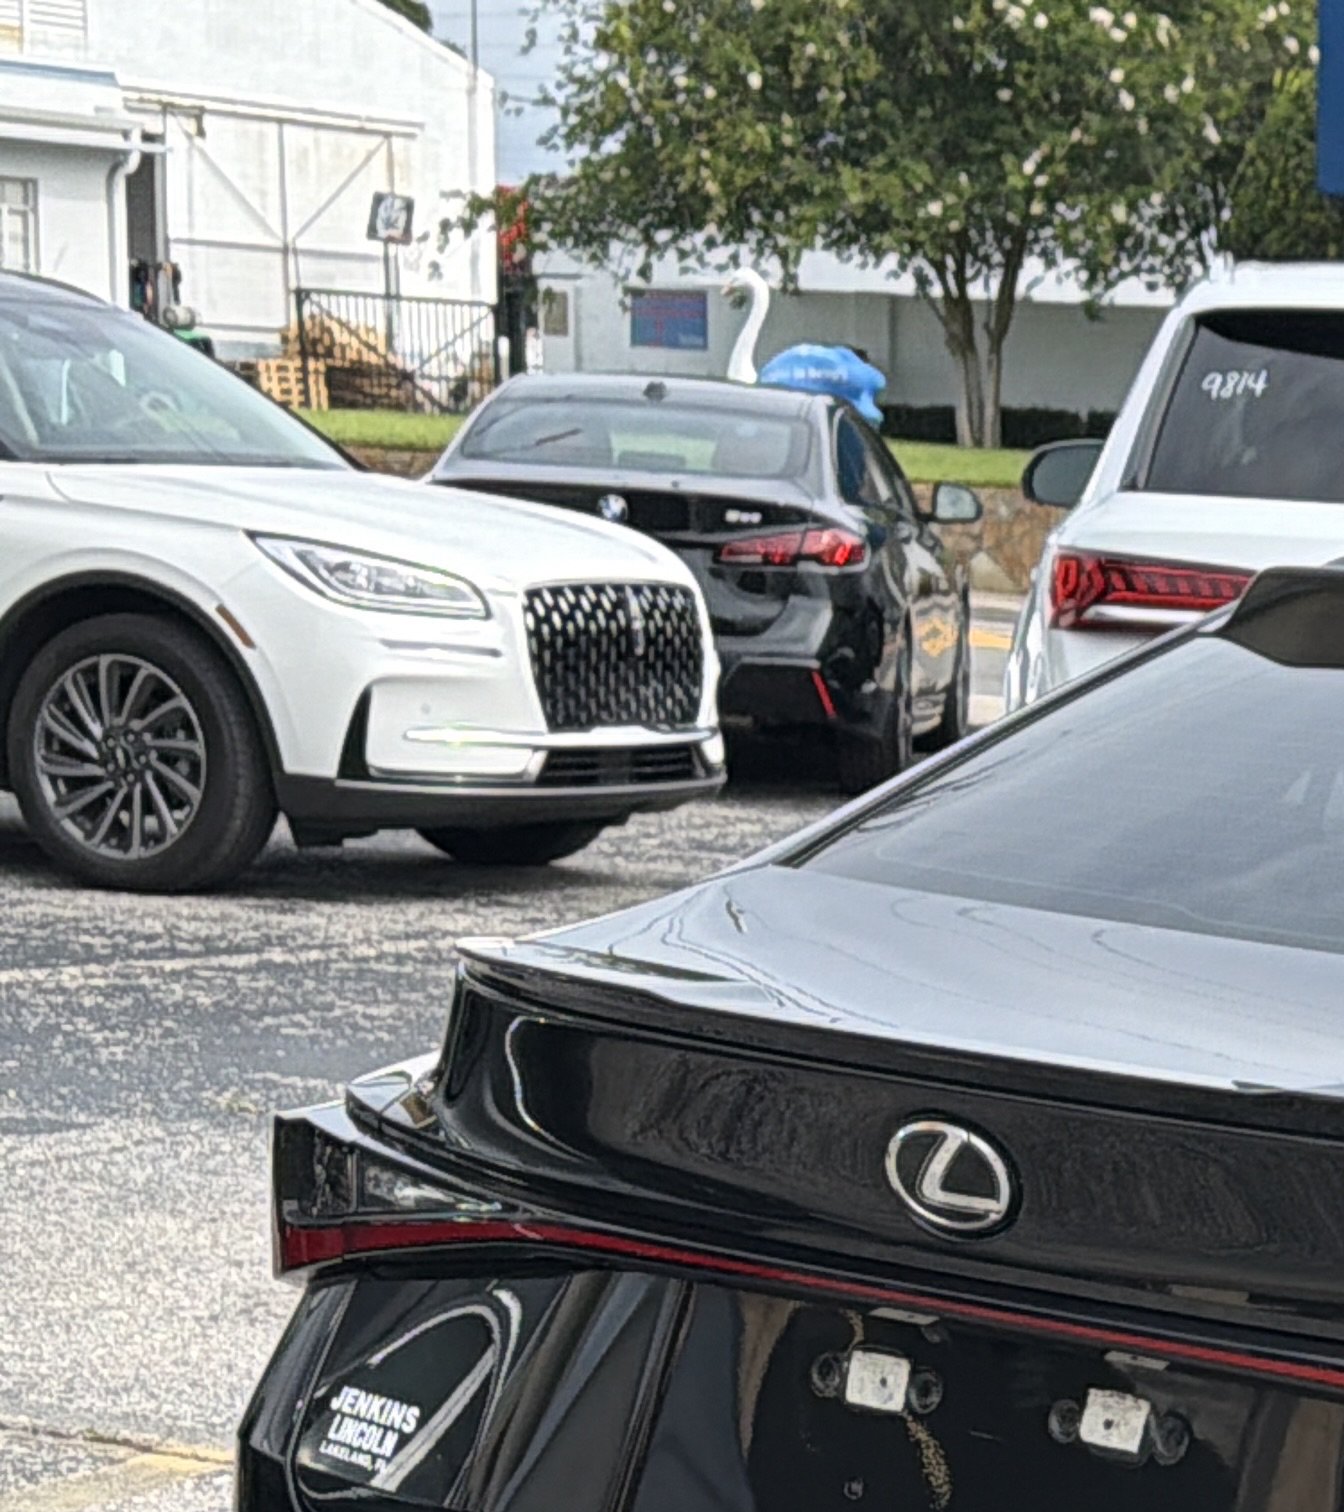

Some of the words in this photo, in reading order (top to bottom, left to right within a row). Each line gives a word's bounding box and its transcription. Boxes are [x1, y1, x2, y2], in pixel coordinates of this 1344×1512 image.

[1201, 369, 1269, 400] 9814
[330, 1385, 420, 1434] JENKINS
[327, 1413, 399, 1457] LINCOLN
